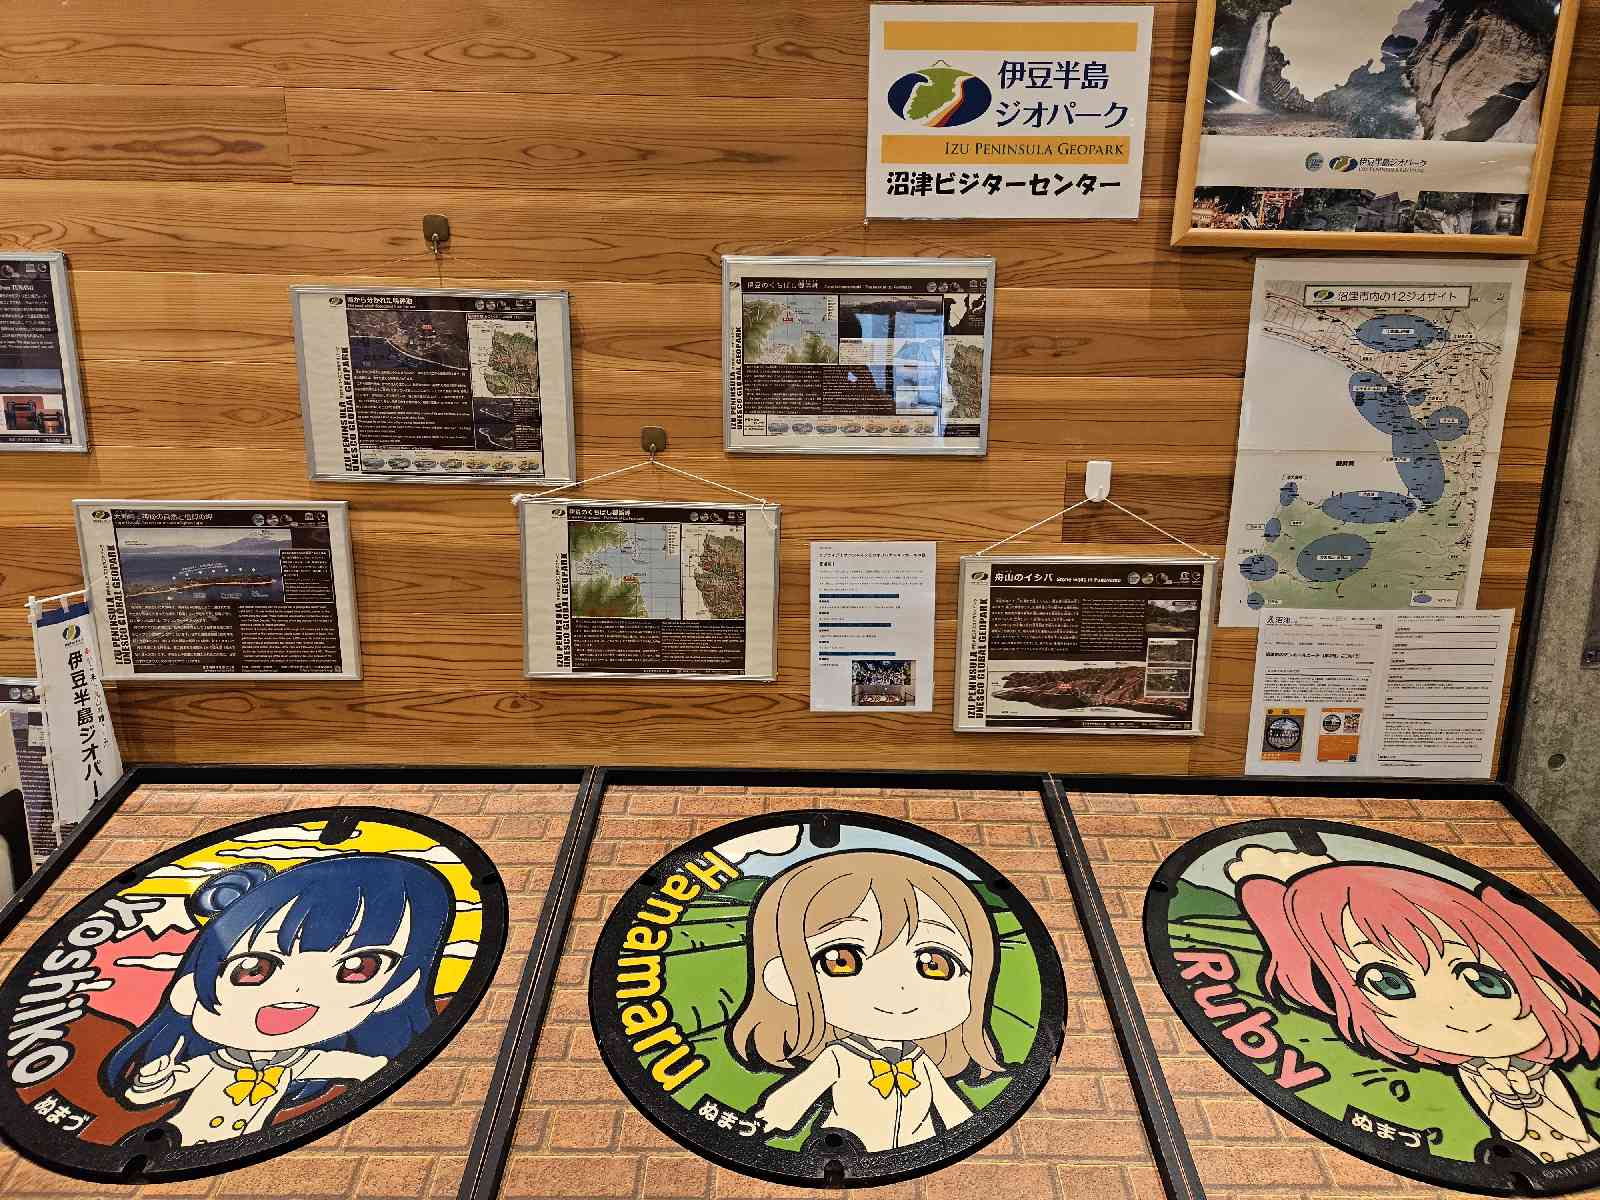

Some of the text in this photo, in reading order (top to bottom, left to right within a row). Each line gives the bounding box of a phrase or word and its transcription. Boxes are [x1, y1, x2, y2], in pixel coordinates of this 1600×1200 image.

[998, 60, 1109, 90] 伊豆半島
[996, 101, 1129, 128] ジオパーク
[944, 142, 1124, 156] IZU PENINSULA GEOPARK
[886, 171, 1121, 196] 沼津ビジターセンター
[994, 573, 1055, 582] 舟山のイシバ
[68, 650, 103, 803] 伊豆半島ジオパー
[616, 851, 740, 1093] Hanamaru
[8, 897, 163, 1085] Yoshiko
[1173, 950, 1327, 1089] Ruby
[33, 1096, 90, 1131] ぬまづ
[698, 1102, 763, 1137] ぬまづ
[1352, 1112, 1423, 1148] ぬまづ
